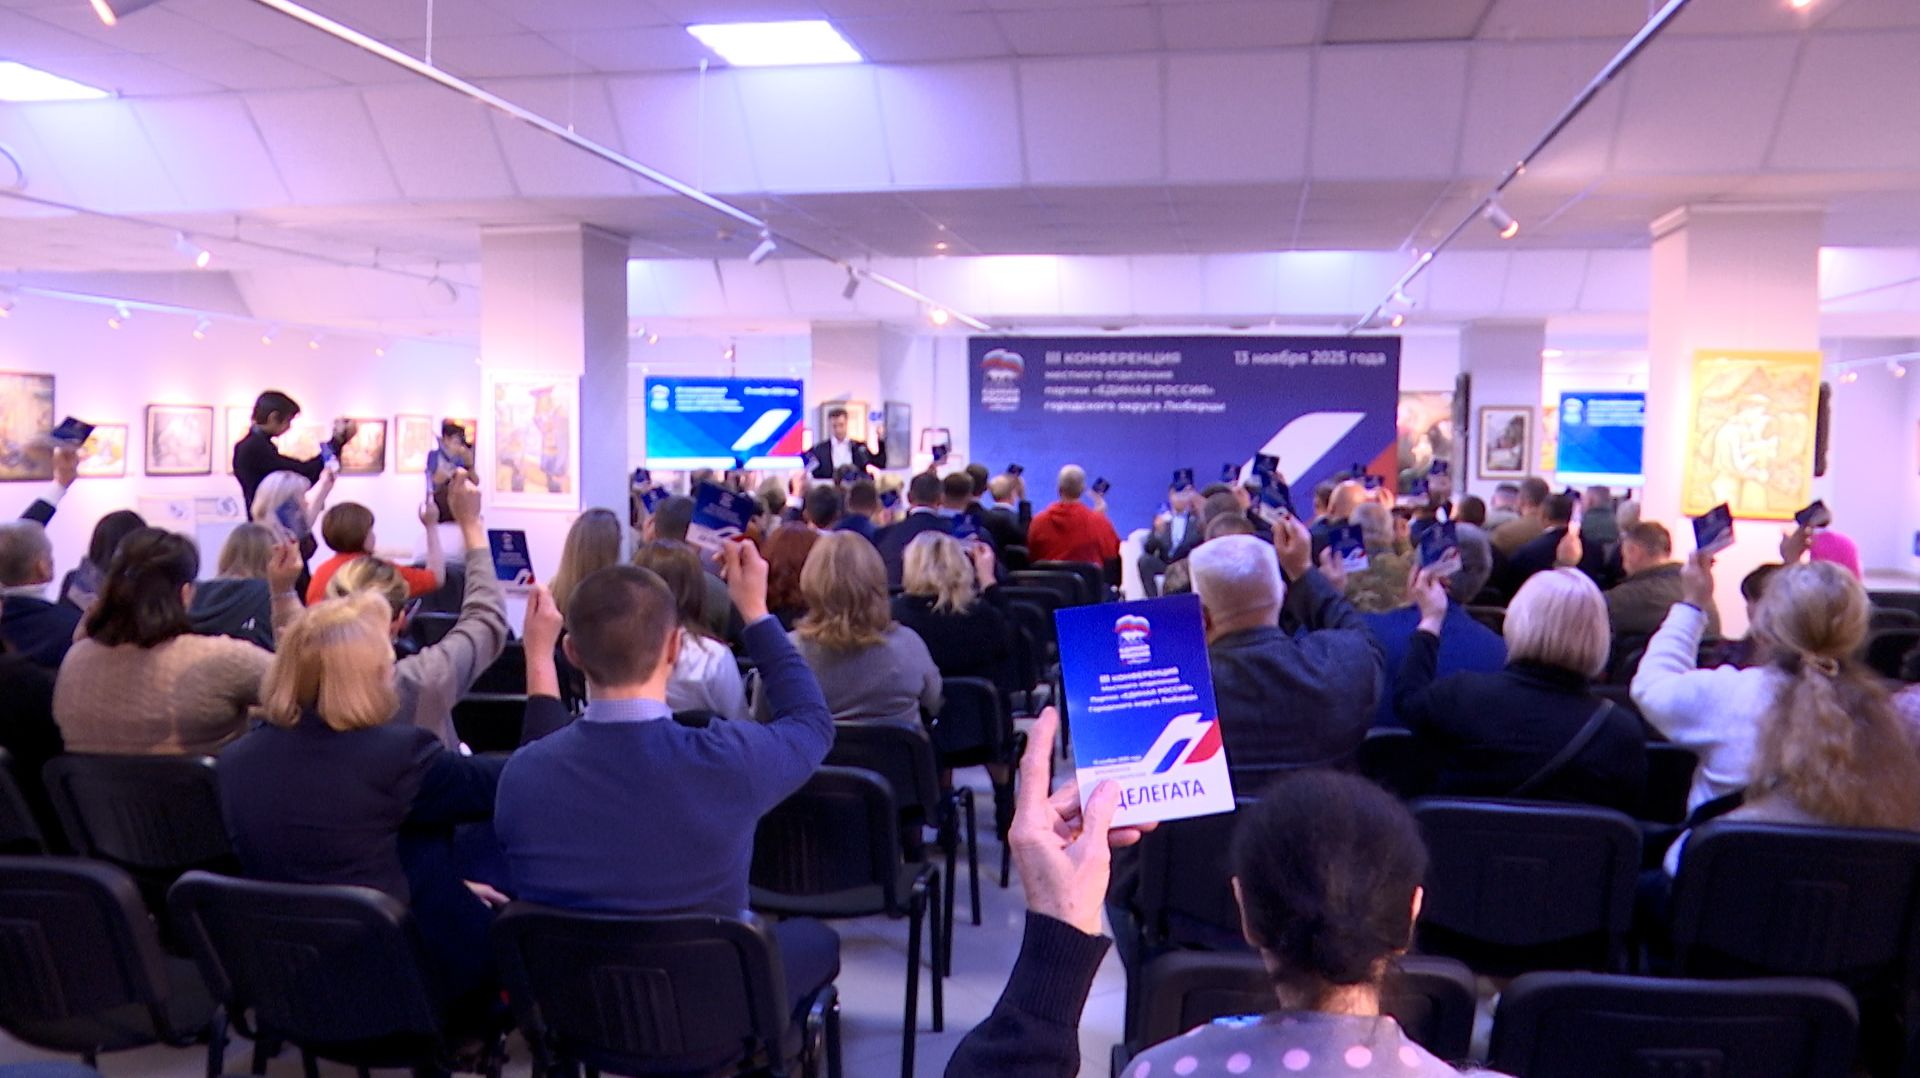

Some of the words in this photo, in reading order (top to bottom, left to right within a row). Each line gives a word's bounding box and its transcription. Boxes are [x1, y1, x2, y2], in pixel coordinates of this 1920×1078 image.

[1063, 351, 1181, 366] КОНФЕРЕНЦИЯ
[1234, 350, 1249, 365] 13
[1252, 349, 1309, 368] ноября
[1311, 350, 1348, 365] 2025
[1350, 352, 1387, 367] года
[1163, 399, 1226, 413] Люберцы
[1111, 666, 1179, 682] КОНФЕРЕНЦИЯ
